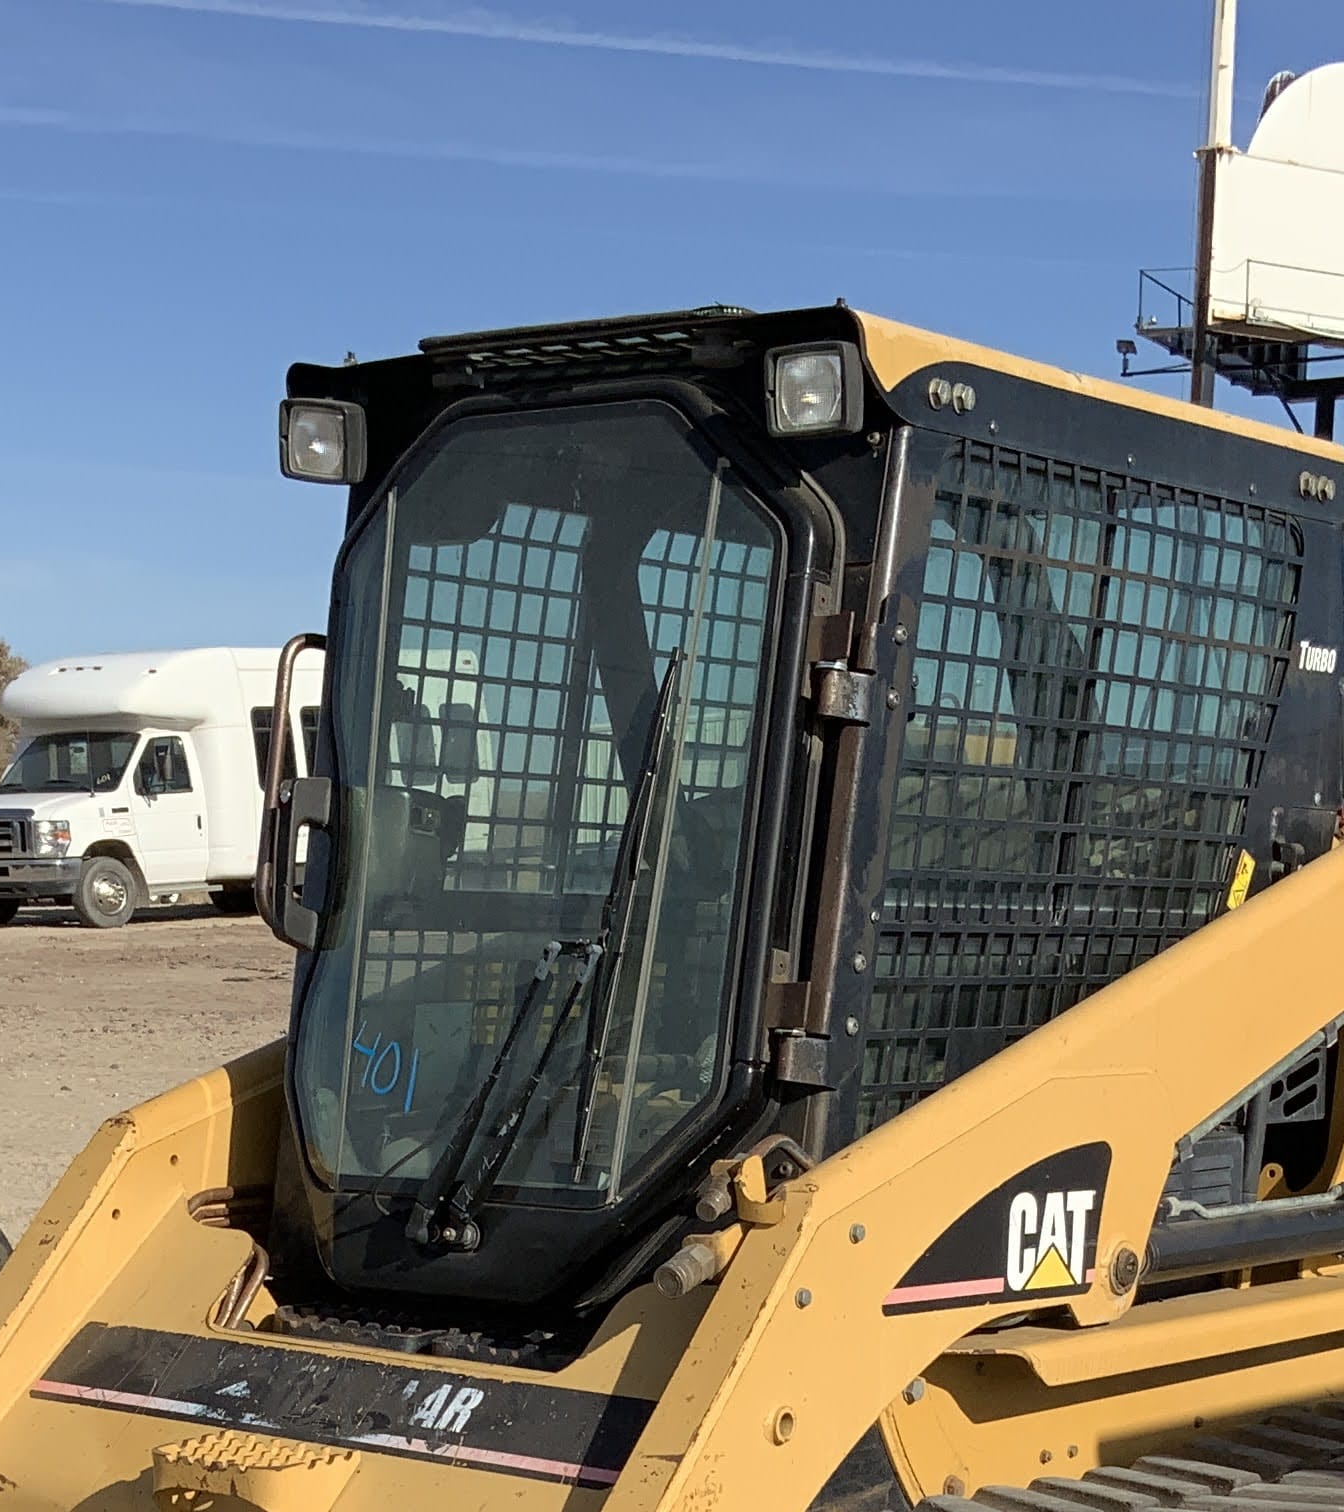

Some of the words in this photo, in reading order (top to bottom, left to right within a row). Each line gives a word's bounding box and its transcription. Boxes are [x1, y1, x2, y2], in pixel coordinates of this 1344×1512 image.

[1298, 640, 1337, 673] TURBO
[352, 1020, 419, 1115] 401
[1007, 1189, 1097, 1291] CAT
